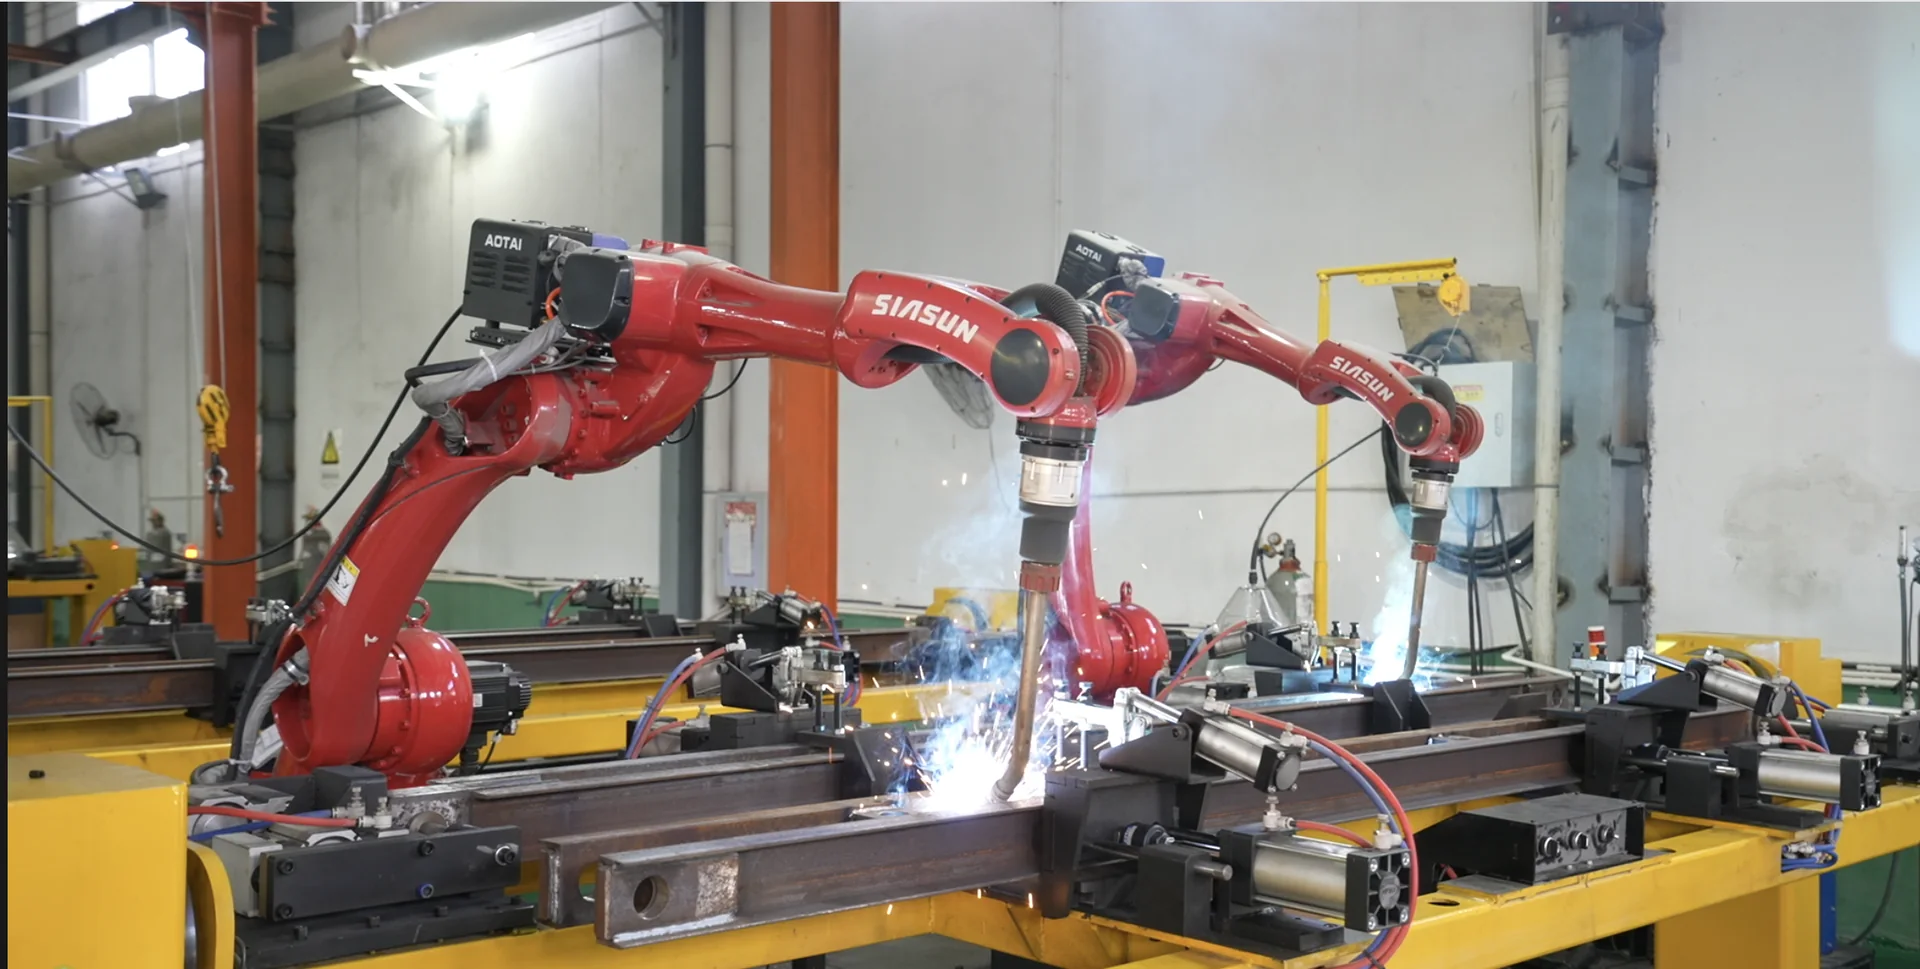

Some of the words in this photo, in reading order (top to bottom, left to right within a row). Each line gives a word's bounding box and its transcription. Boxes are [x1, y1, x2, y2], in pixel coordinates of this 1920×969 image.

[484, 233, 523, 251] AOTAI
[1075, 243, 1103, 263] AOTAI
[871, 293, 980, 344] SIASUN
[1328, 355, 1395, 402] SIASUN
